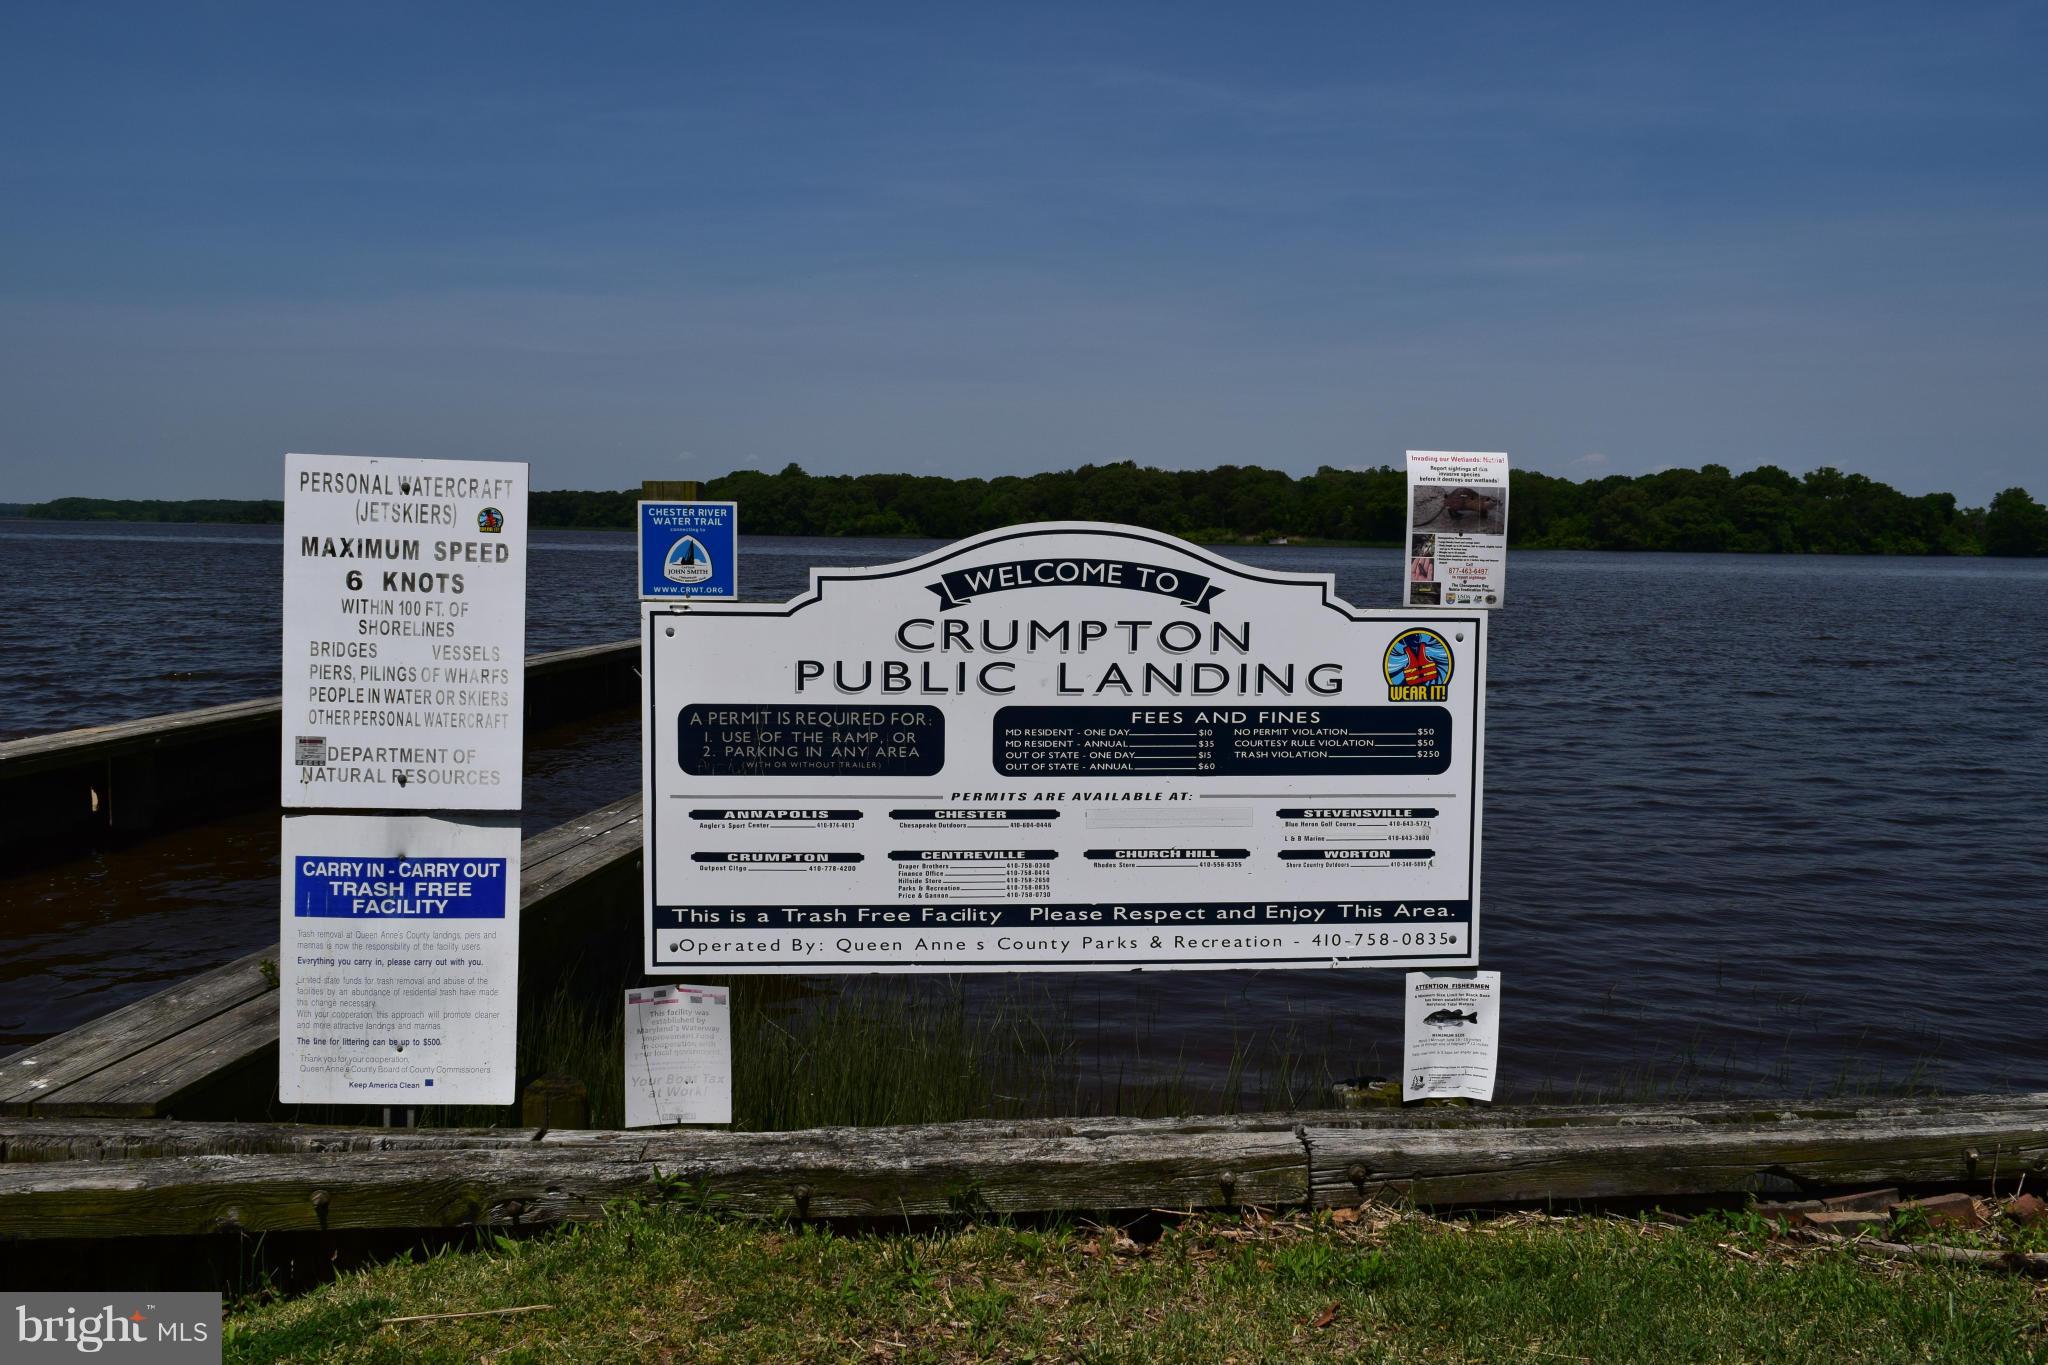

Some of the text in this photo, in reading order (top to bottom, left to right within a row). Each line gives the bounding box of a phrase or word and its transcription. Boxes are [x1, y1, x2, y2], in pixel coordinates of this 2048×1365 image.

[300, 471, 393, 495] PERSONAL
[356, 499, 457, 528] (JETSKIERS)
[649, 508, 727, 517] CHESTER RIVER
[653, 517, 690, 525] WATER
[301, 536, 509, 563] MAXIMUM SPEED
[346, 570, 464, 594] 6 KNOTS
[964, 559, 1179, 593] WELCOME TO
[341, 599, 469, 617] WITHIN 100 FT. OF
[359, 619, 455, 638] SHORELINES
[894, 618, 1251, 655] CRUMPTON
[310, 641, 500, 662] BRIDGES VESSELS
[310, 664, 509, 684] PIERS, PILINGS OF WHARFS
[795, 660, 1344, 697] PUBLIC LANDING
[309, 687, 508, 707] PEOPLE IN WATER OR SKIERS
[1390, 686, 1446, 700] WEAR IT!
[309, 709, 509, 729] OTHER PERSONAL WATERCRAFT
[690, 712, 933, 726] A PERMIT IS REQUIRED FOR:
[1131, 711, 1321, 724] FEES AND FINES
[722, 731, 751, 743] USE
[759, 732, 782, 743] OF
[792, 731, 824, 743] THE
[832, 732, 883, 744] RAMP,
[892, 732, 916, 743] OR
[1198, 729, 1213, 737] $10
[1234, 728, 1435, 736] NO PERMIT VIOLATION $50
[1234, 739, 1434, 747] COURTESY RULE VIOLATION $50
[327, 747, 448, 764] DEPARTMENT
[453, 749, 476, 764] OF
[703, 746, 920, 758] 2. PARKING IN ANY AREA
[1417, 750, 1440, 758] $250
[302, 767, 500, 786] NATURAL RESOURCES
[951, 792, 1193, 801] PERMITS ARE AVAILABLE AT:
[724, 811, 829, 819] ANNAPOLIS
[921, 851, 1026, 859] CENTREVILLE
[1115, 850, 1219, 858] CHURCH HILL
[303, 861, 362, 877] CARRY
[367, 863, 384, 878] IN
[399, 862, 458, 878] CARRY
[463, 863, 500, 878] OUT
[329, 881, 472, 897] TRASH FREE
[353, 899, 449, 914] FACILITY
[672, 904, 1456, 926] This is a Trash Free Facility Please Respect and Enjoy This Area.
[679, 938, 781, 955] Operated
[792, 938, 825, 955] By:
[836, 938, 903, 952] Queen
[915, 937, 967, 951] Anne
[997, 937, 1071, 953] County
[1082, 935, 1138, 949] Parks
[1150, 935, 1163, 949] &
[1174, 934, 1283, 949] Recreation
[1311, 932, 1449, 947] 410-758-0835
[297, 957, 334, 967] Everything
[354, 959, 372, 967] carry
[375, 957, 385, 967] in,
[387, 957, 411, 967] please
[414, 958, 432, 967] carry
[435, 958, 447, 966] out
[450, 957, 465, 966] with
[468, 959, 484, 967] you.
[349, 1081, 367, 1089] Keep
